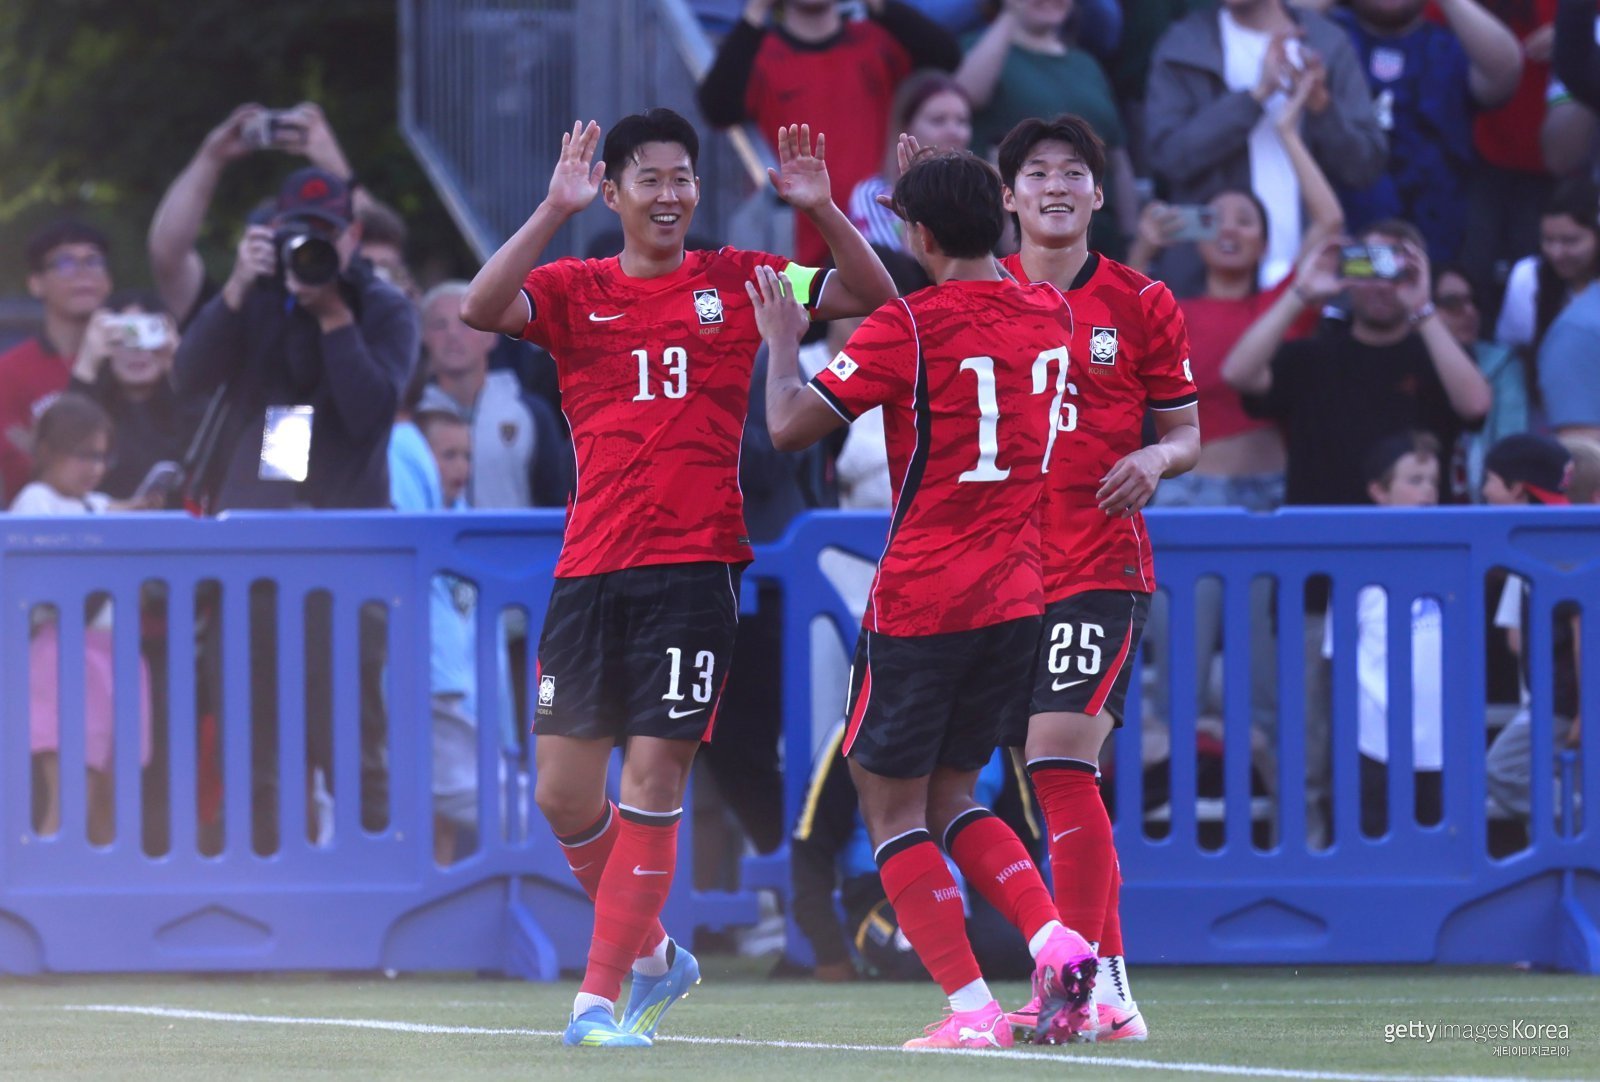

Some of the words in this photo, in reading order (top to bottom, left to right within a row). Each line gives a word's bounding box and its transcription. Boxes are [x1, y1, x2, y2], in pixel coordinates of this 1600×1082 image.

[699, 327, 721, 335] KORE
[631, 346, 688, 402] 13
[1088, 366, 1115, 376] KORE
[958, 345, 1069, 483] 17
[661, 647, 715, 703] 13
[1048, 622, 1105, 675] 25
[931, 886, 961, 903] KORE
